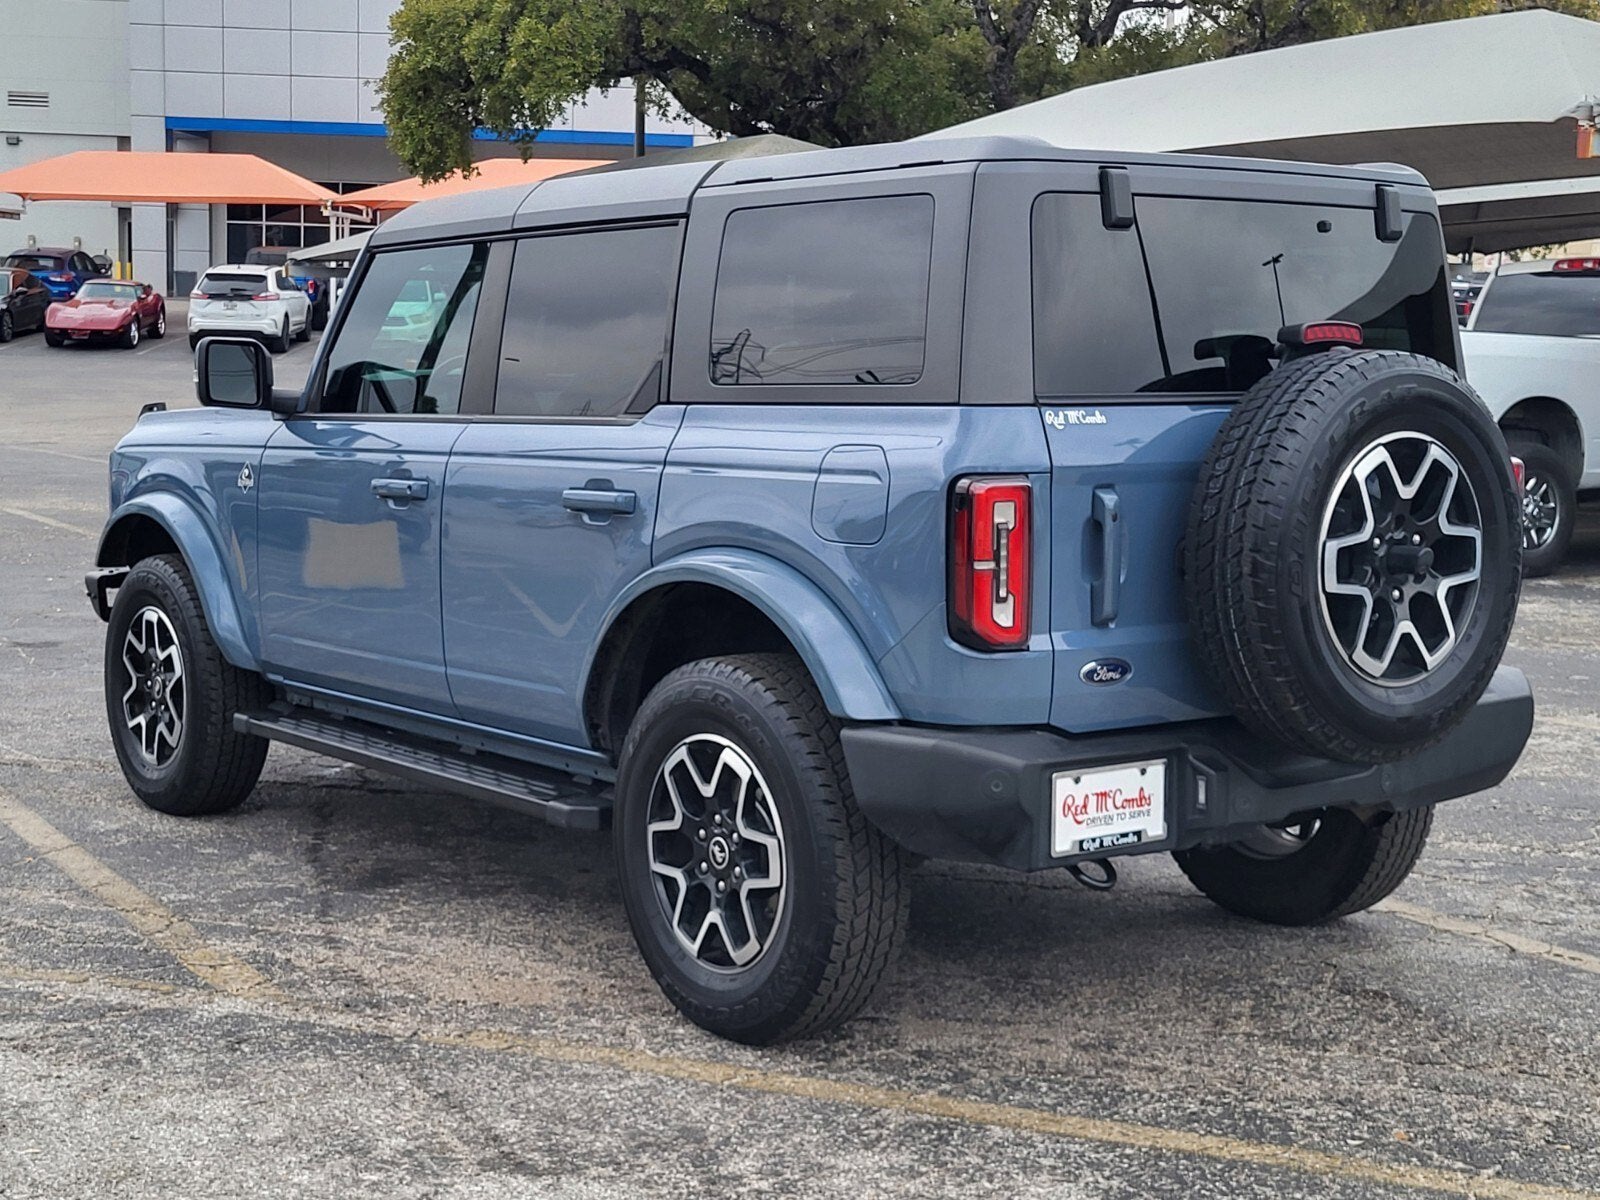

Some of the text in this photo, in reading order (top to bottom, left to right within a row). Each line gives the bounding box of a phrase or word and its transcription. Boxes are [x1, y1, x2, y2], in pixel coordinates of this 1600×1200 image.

[1045, 410, 1107, 430] Red McCombs
[1093, 665, 1121, 681] Ford
[1062, 786, 1152, 825] Red McCombs
[1086, 808, 1152, 826] DRIVEN TO SERVE
